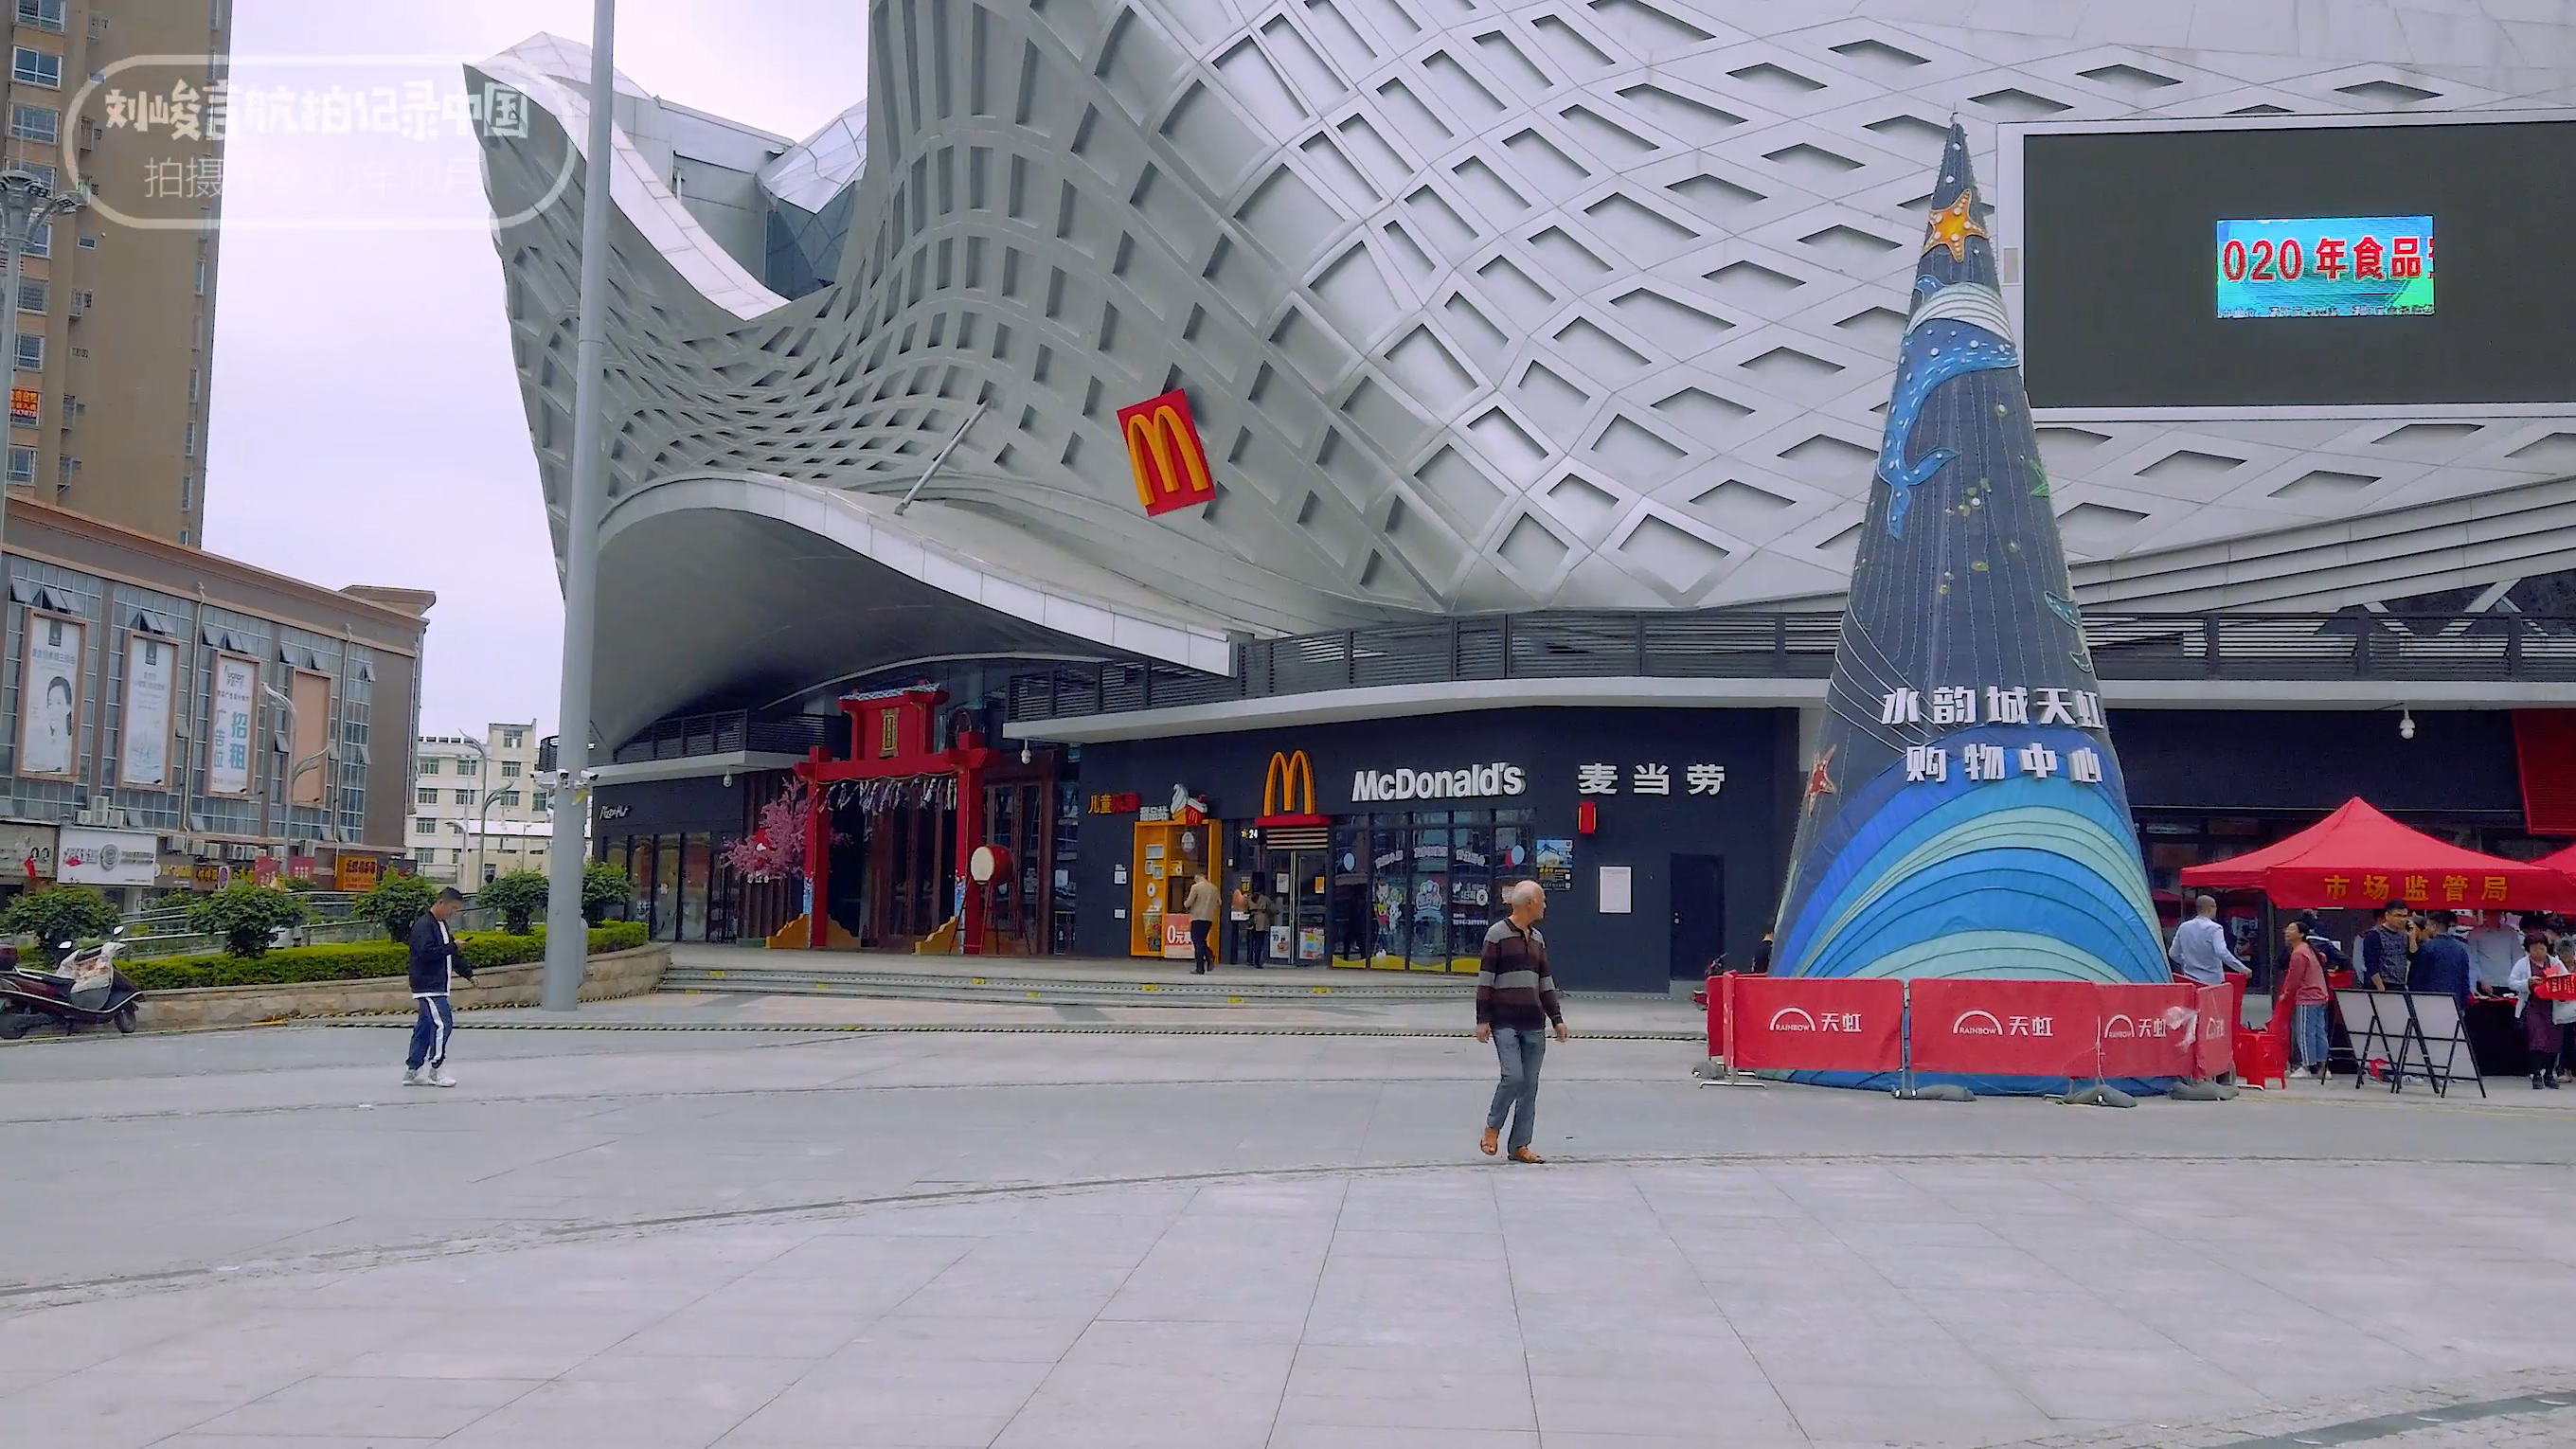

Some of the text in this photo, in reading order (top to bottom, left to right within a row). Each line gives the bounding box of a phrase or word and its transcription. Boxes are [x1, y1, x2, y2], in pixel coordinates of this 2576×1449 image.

[1881, 686, 2104, 729] 水韵城天虹
[229, 711, 249, 770] 招租
[1577, 762, 1726, 796] 麦当劳
[1906, 742, 2103, 783] 购物中心
[1351, 761, 1526, 802] McDonald's
[2324, 874, 2508, 902] 市场监管局
[1821, 1012, 1862, 1032] 天虹
[1959, 1015, 2053, 1037] RAINBOW 天虹
[2138, 1018, 2167, 1038] 天虹
